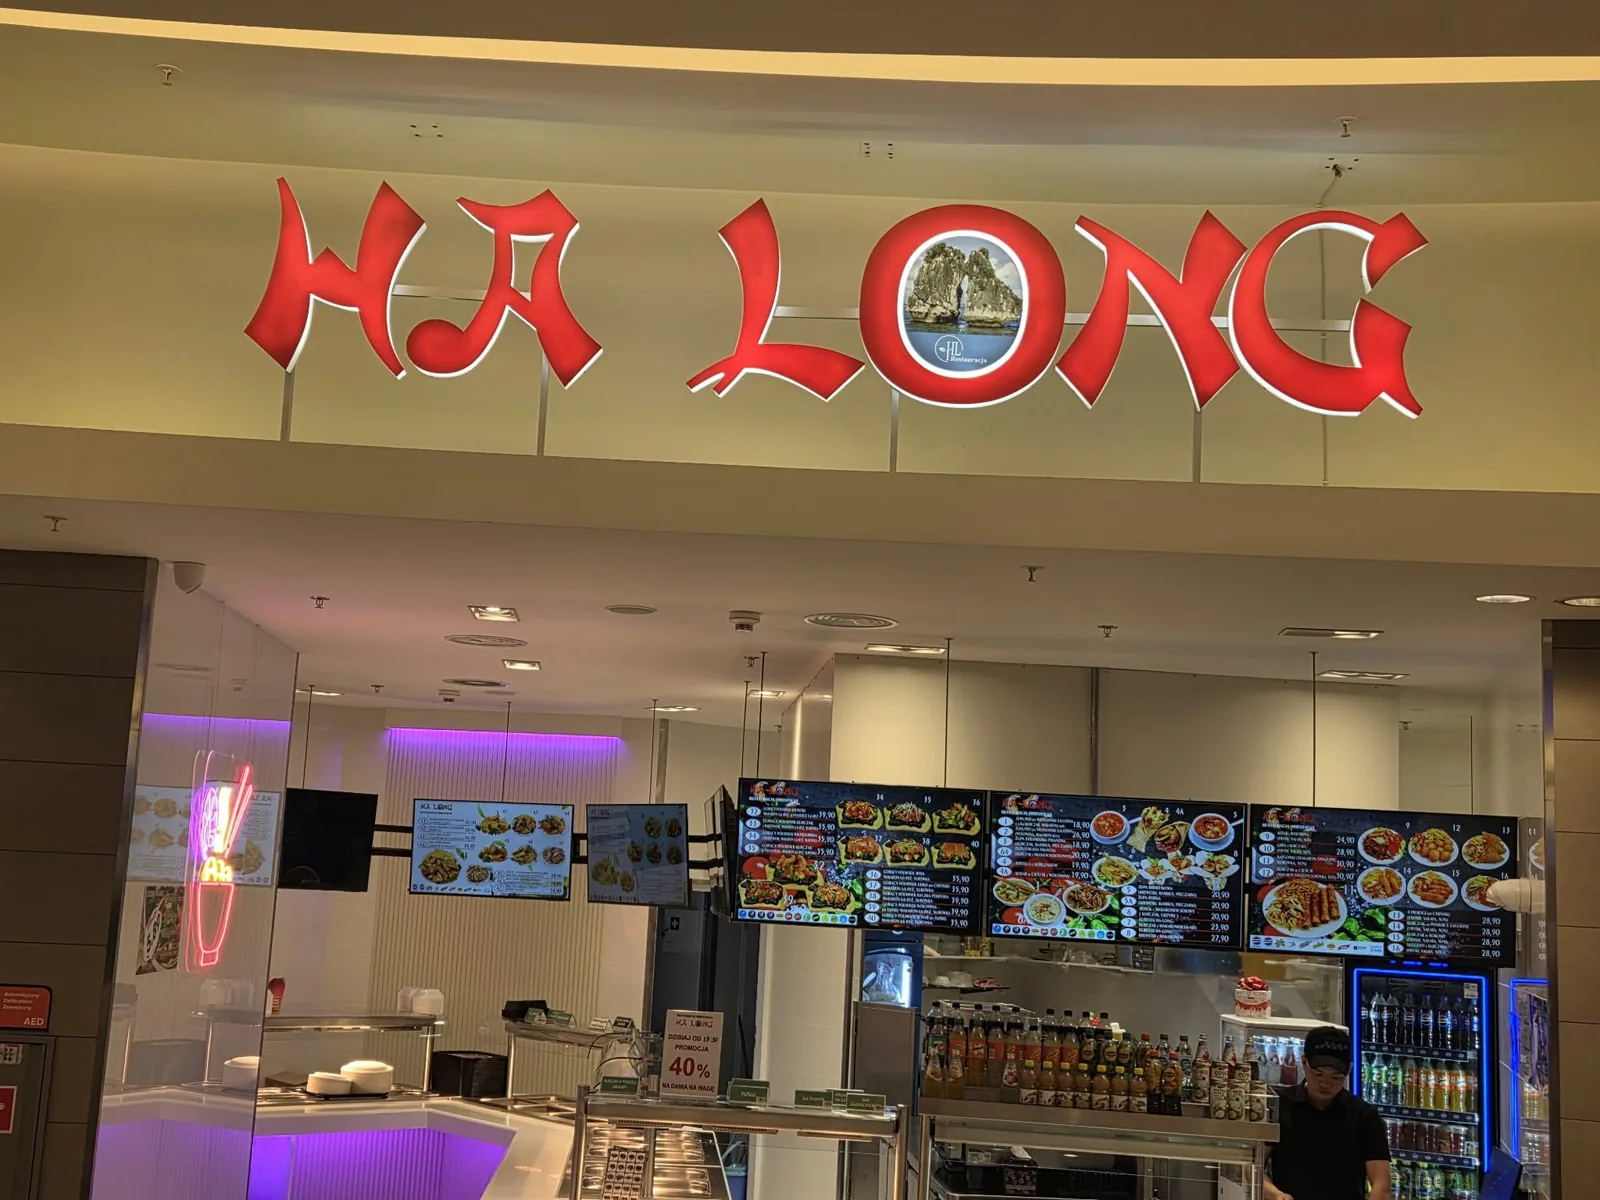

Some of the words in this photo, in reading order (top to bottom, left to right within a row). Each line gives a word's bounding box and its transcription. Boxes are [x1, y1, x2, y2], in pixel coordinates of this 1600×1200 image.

[243, 176, 604, 390] HA
[685, 196, 1429, 419] LONG
[951, 356, 987, 364] Restauracja
[1073, 821, 1090, 829] 18,90
[1452, 824, 1461, 832] 12
[1336, 836, 1354, 844] 24,90
[1072, 841, 1089, 849] 18,90
[1336, 848, 1354, 856] 28,90
[952, 875, 969, 883] 35,90
[952, 886, 969, 894] 35,90
[1211, 891, 1229, 899] 20,90
[1211, 902, 1229, 910] 20,90
[951, 908, 968, 916] 39,90
[1211, 913, 1229, 921] 20,90
[1481, 917, 1501, 925] 28,90
[951, 919, 968, 927] 35,90
[1481, 928, 1500, 937] 28,90
[1481, 939, 1500, 947] 28,90
[1392, 944, 1400, 952] 16
[1481, 950, 1500, 958] 28,90
[24, 1017, 44, 1026] AED
[675, 1044, 709, 1052] PROMOCJA
[669, 1056, 710, 1078] 40%
